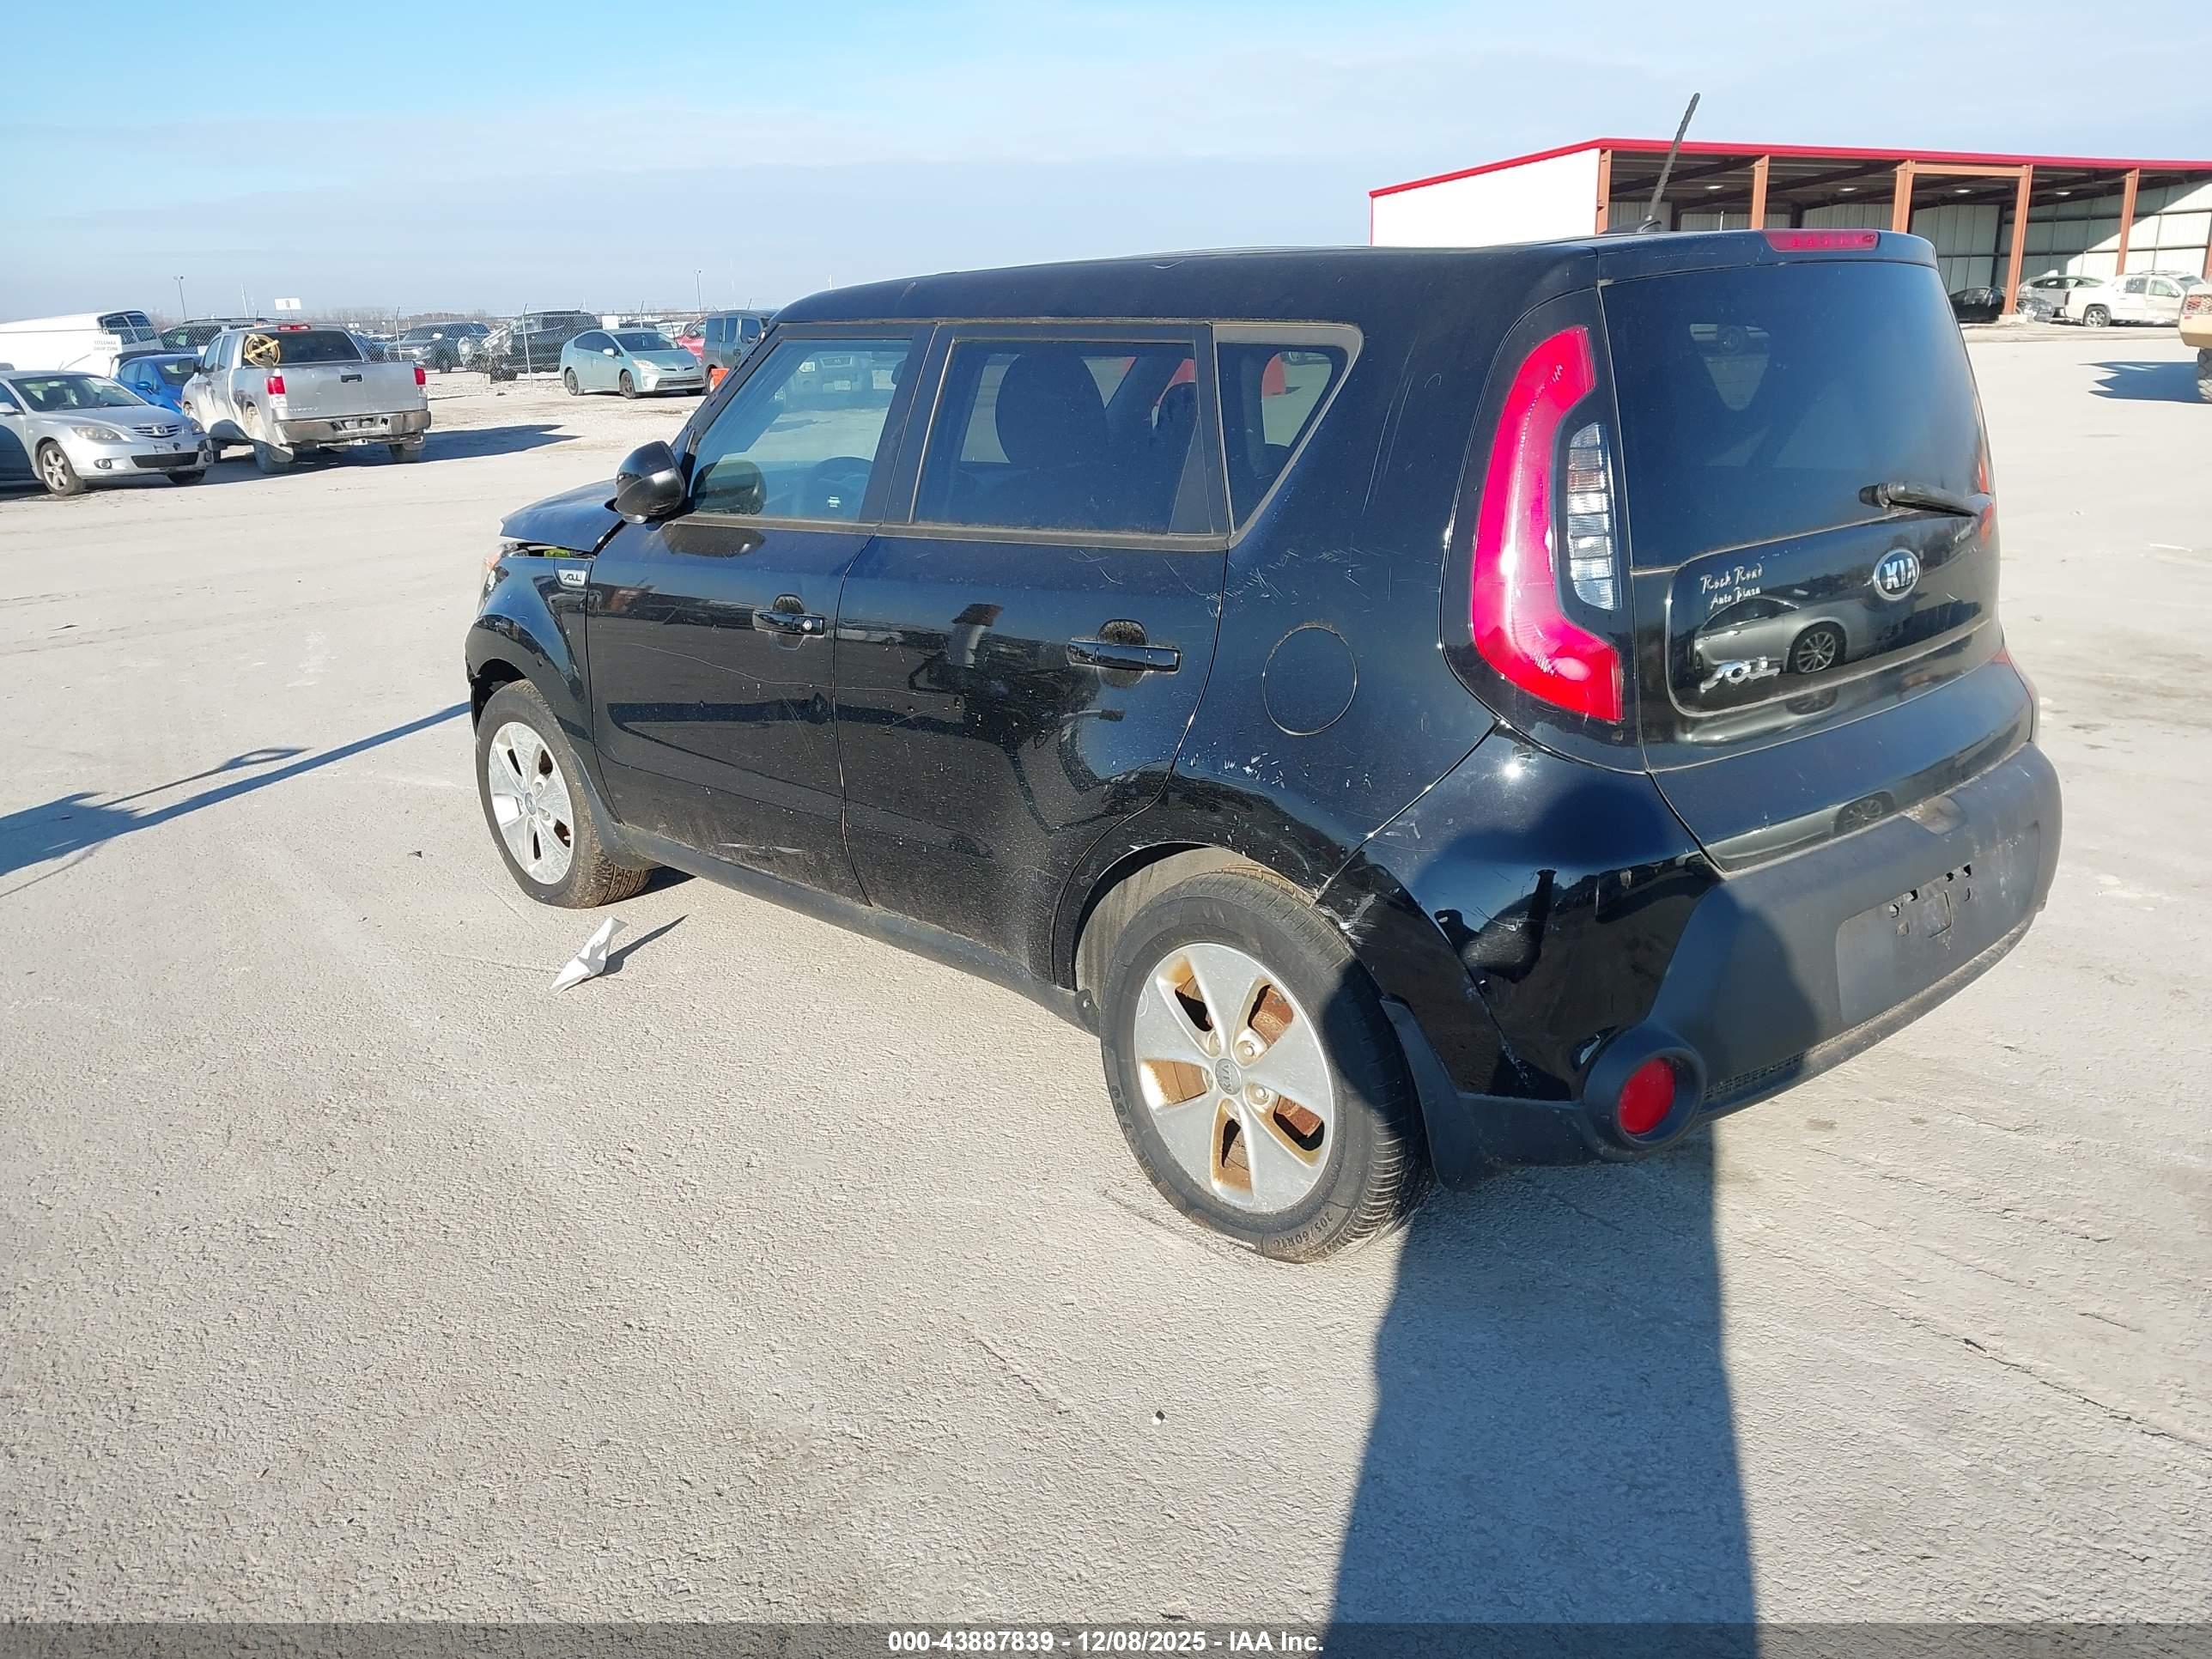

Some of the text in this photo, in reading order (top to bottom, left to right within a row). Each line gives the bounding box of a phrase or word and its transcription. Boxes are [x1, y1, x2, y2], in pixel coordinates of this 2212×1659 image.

[1734, 562, 1763, 586] Road
[1883, 557, 1917, 590] KIA
[1710, 592, 1732, 610] Auto
